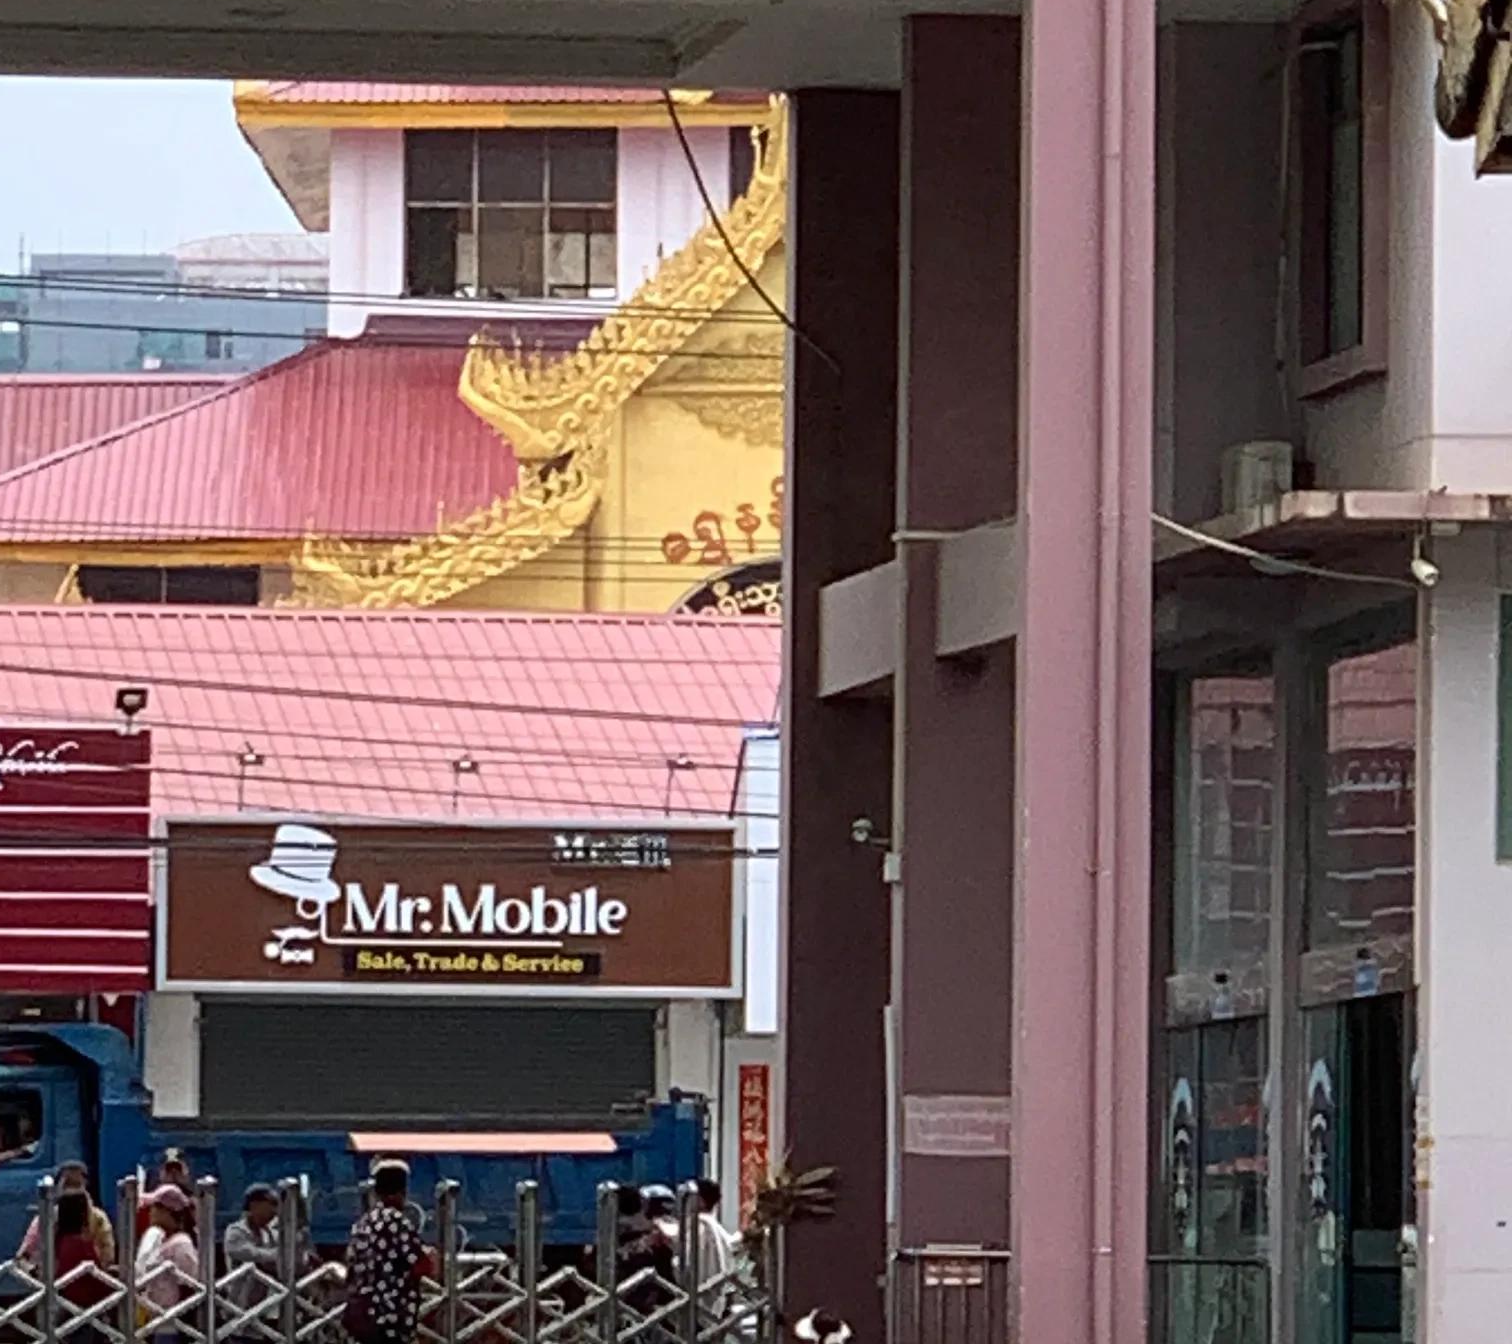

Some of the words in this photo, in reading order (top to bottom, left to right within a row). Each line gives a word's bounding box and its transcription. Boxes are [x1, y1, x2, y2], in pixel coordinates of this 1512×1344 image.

[356, 950, 412, 973] Sale,
[412, 952, 479, 972] Trade
[481, 952, 500, 972] &
[502, 953, 584, 973] Service
